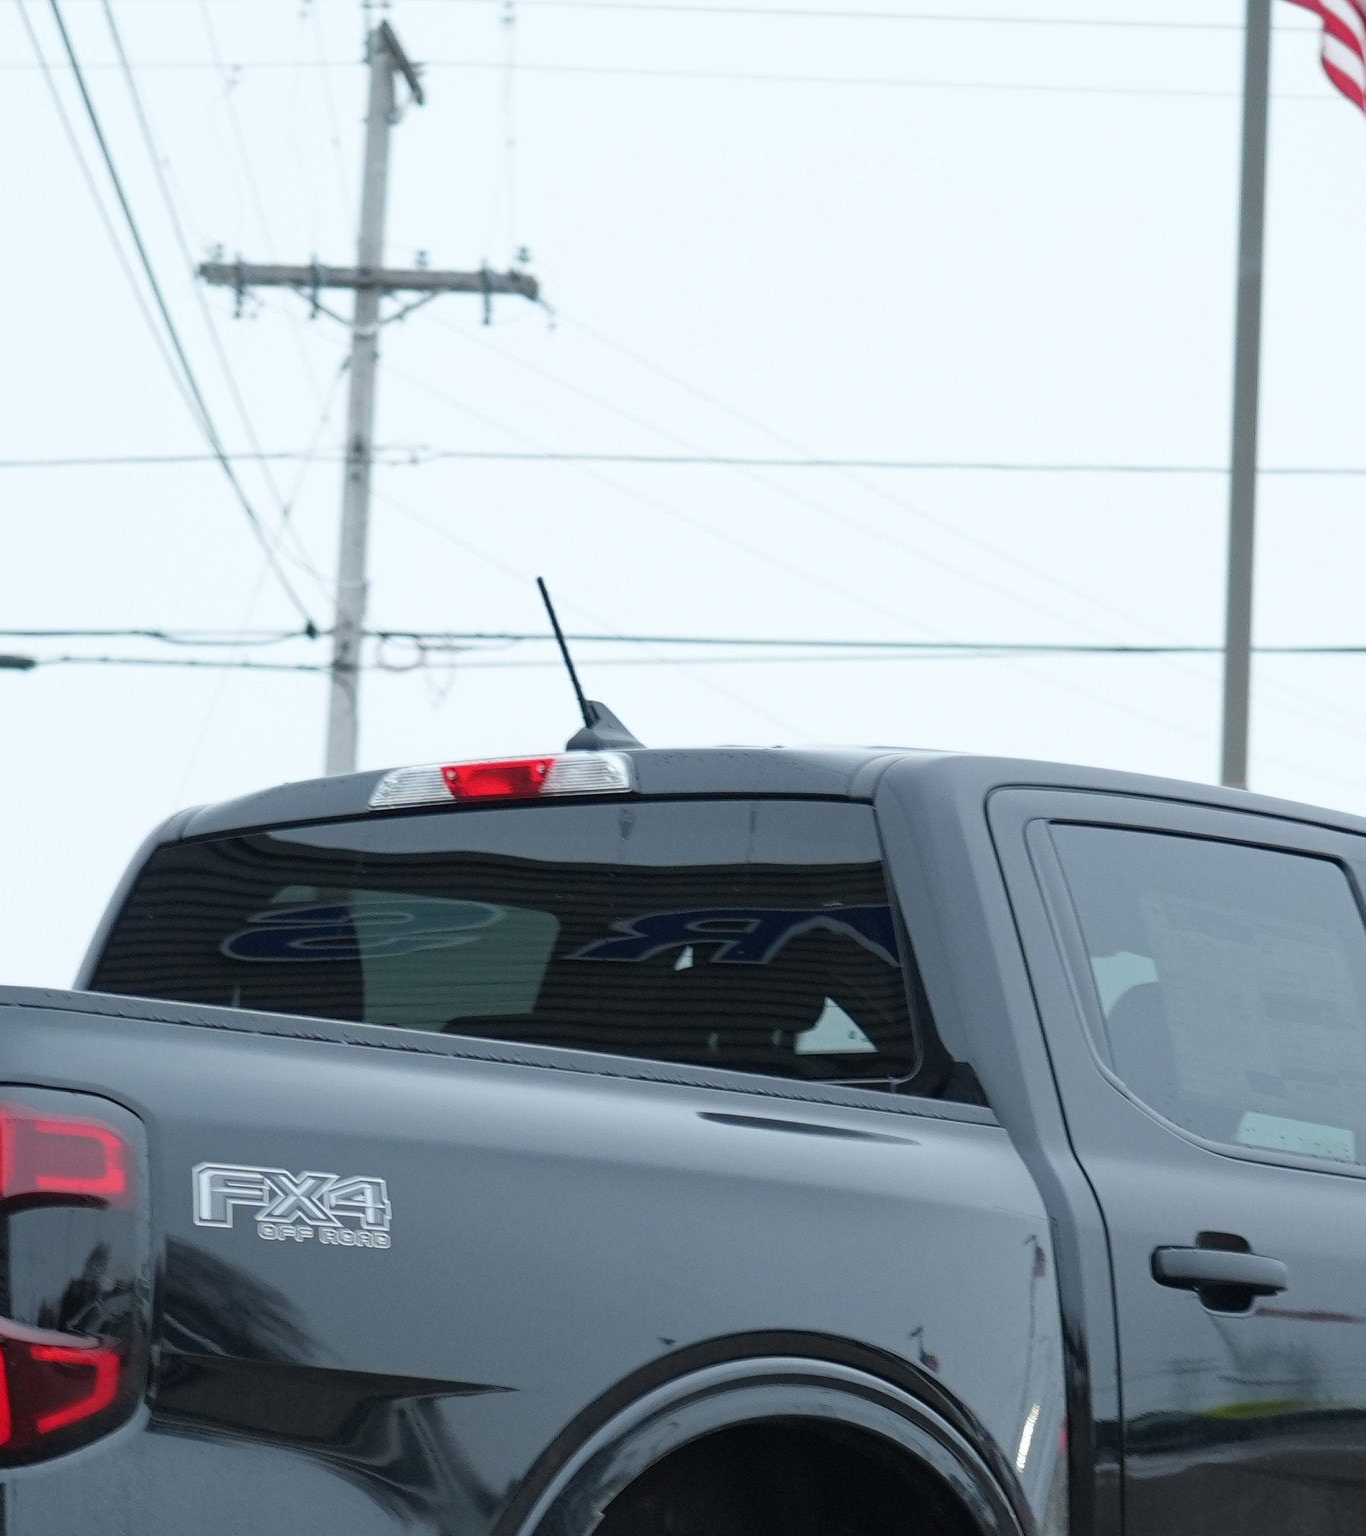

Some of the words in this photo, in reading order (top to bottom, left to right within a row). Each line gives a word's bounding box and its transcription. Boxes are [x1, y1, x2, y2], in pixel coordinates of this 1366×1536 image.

[191, 1162, 392, 1232] FX4
[256, 1222, 314, 1242] OFF
[319, 1226, 391, 1249] ROAD
